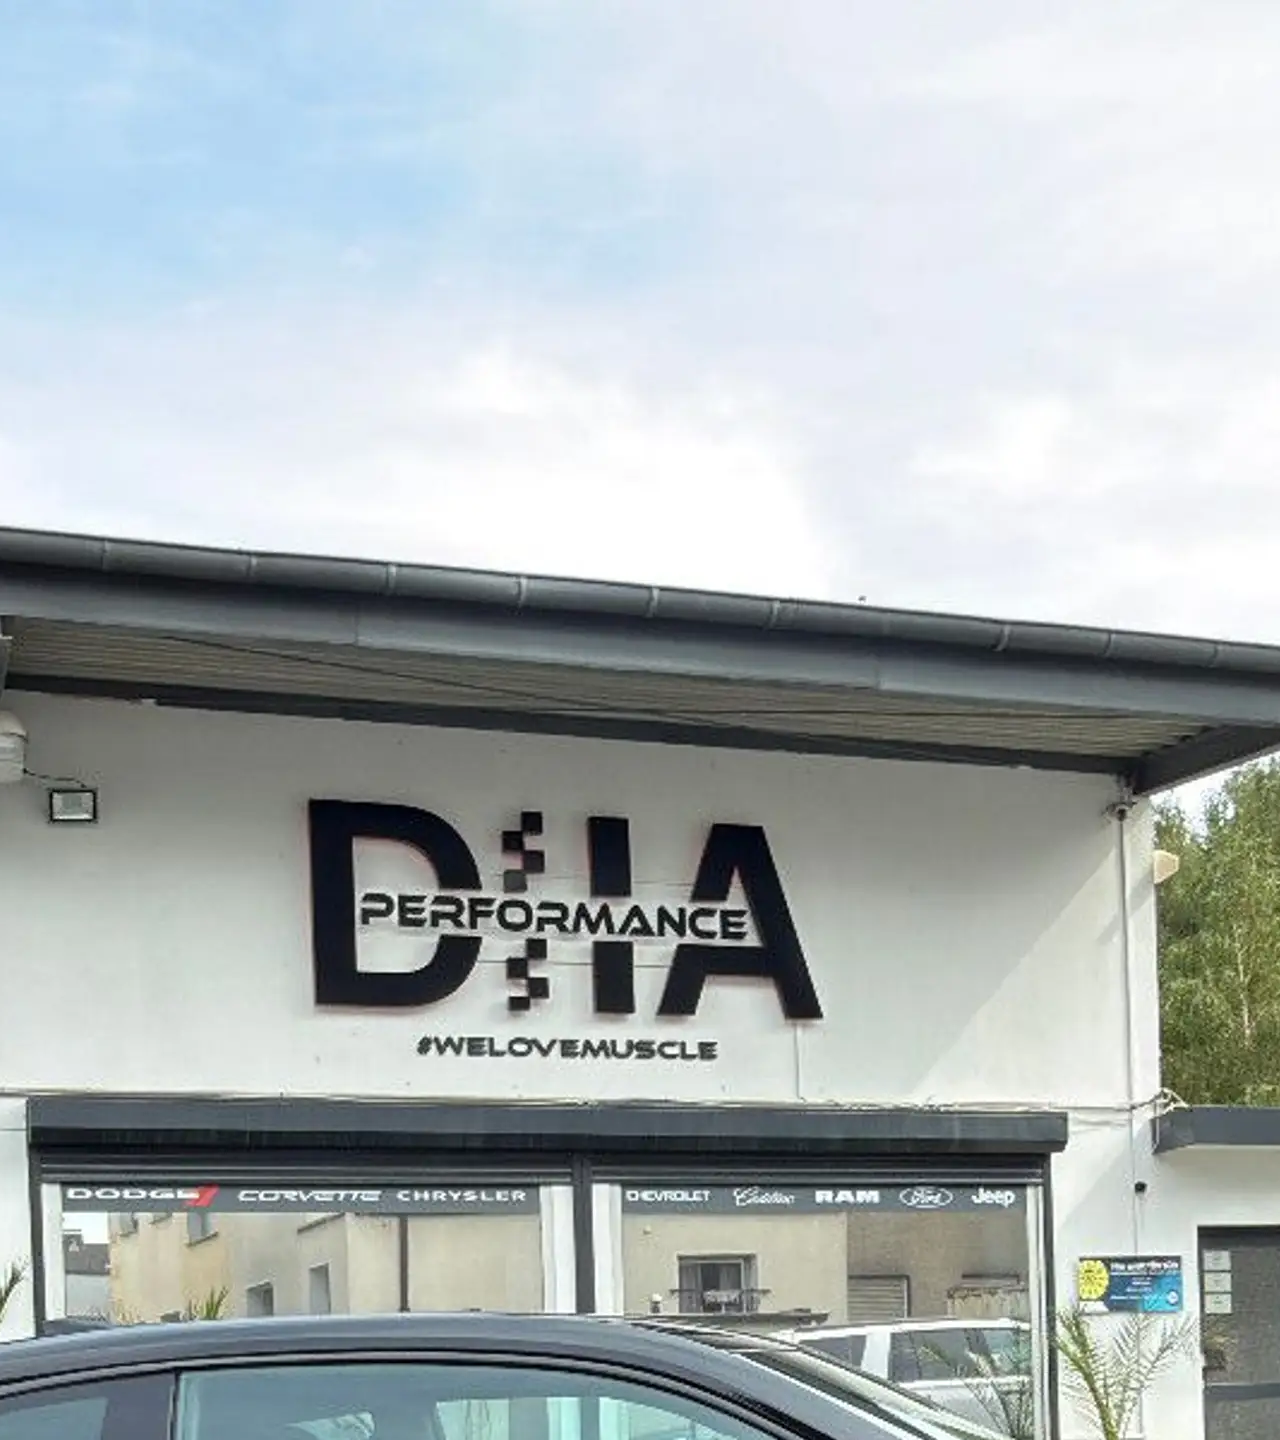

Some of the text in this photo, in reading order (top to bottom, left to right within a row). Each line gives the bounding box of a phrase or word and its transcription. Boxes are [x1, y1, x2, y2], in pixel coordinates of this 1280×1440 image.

[361, 892, 749, 940] PERFORMANCE
[416, 1036, 718, 1060] #WELOVEMUSCLE
[67, 1187, 201, 1200] DODGE
[238, 1190, 382, 1201] CORVETTE
[396, 1189, 526, 1201] CHRYSLER
[626, 1190, 711, 1202] CHEVROLET
[815, 1190, 880, 1204] RAM
[971, 1187, 1015, 1208] Jeep
